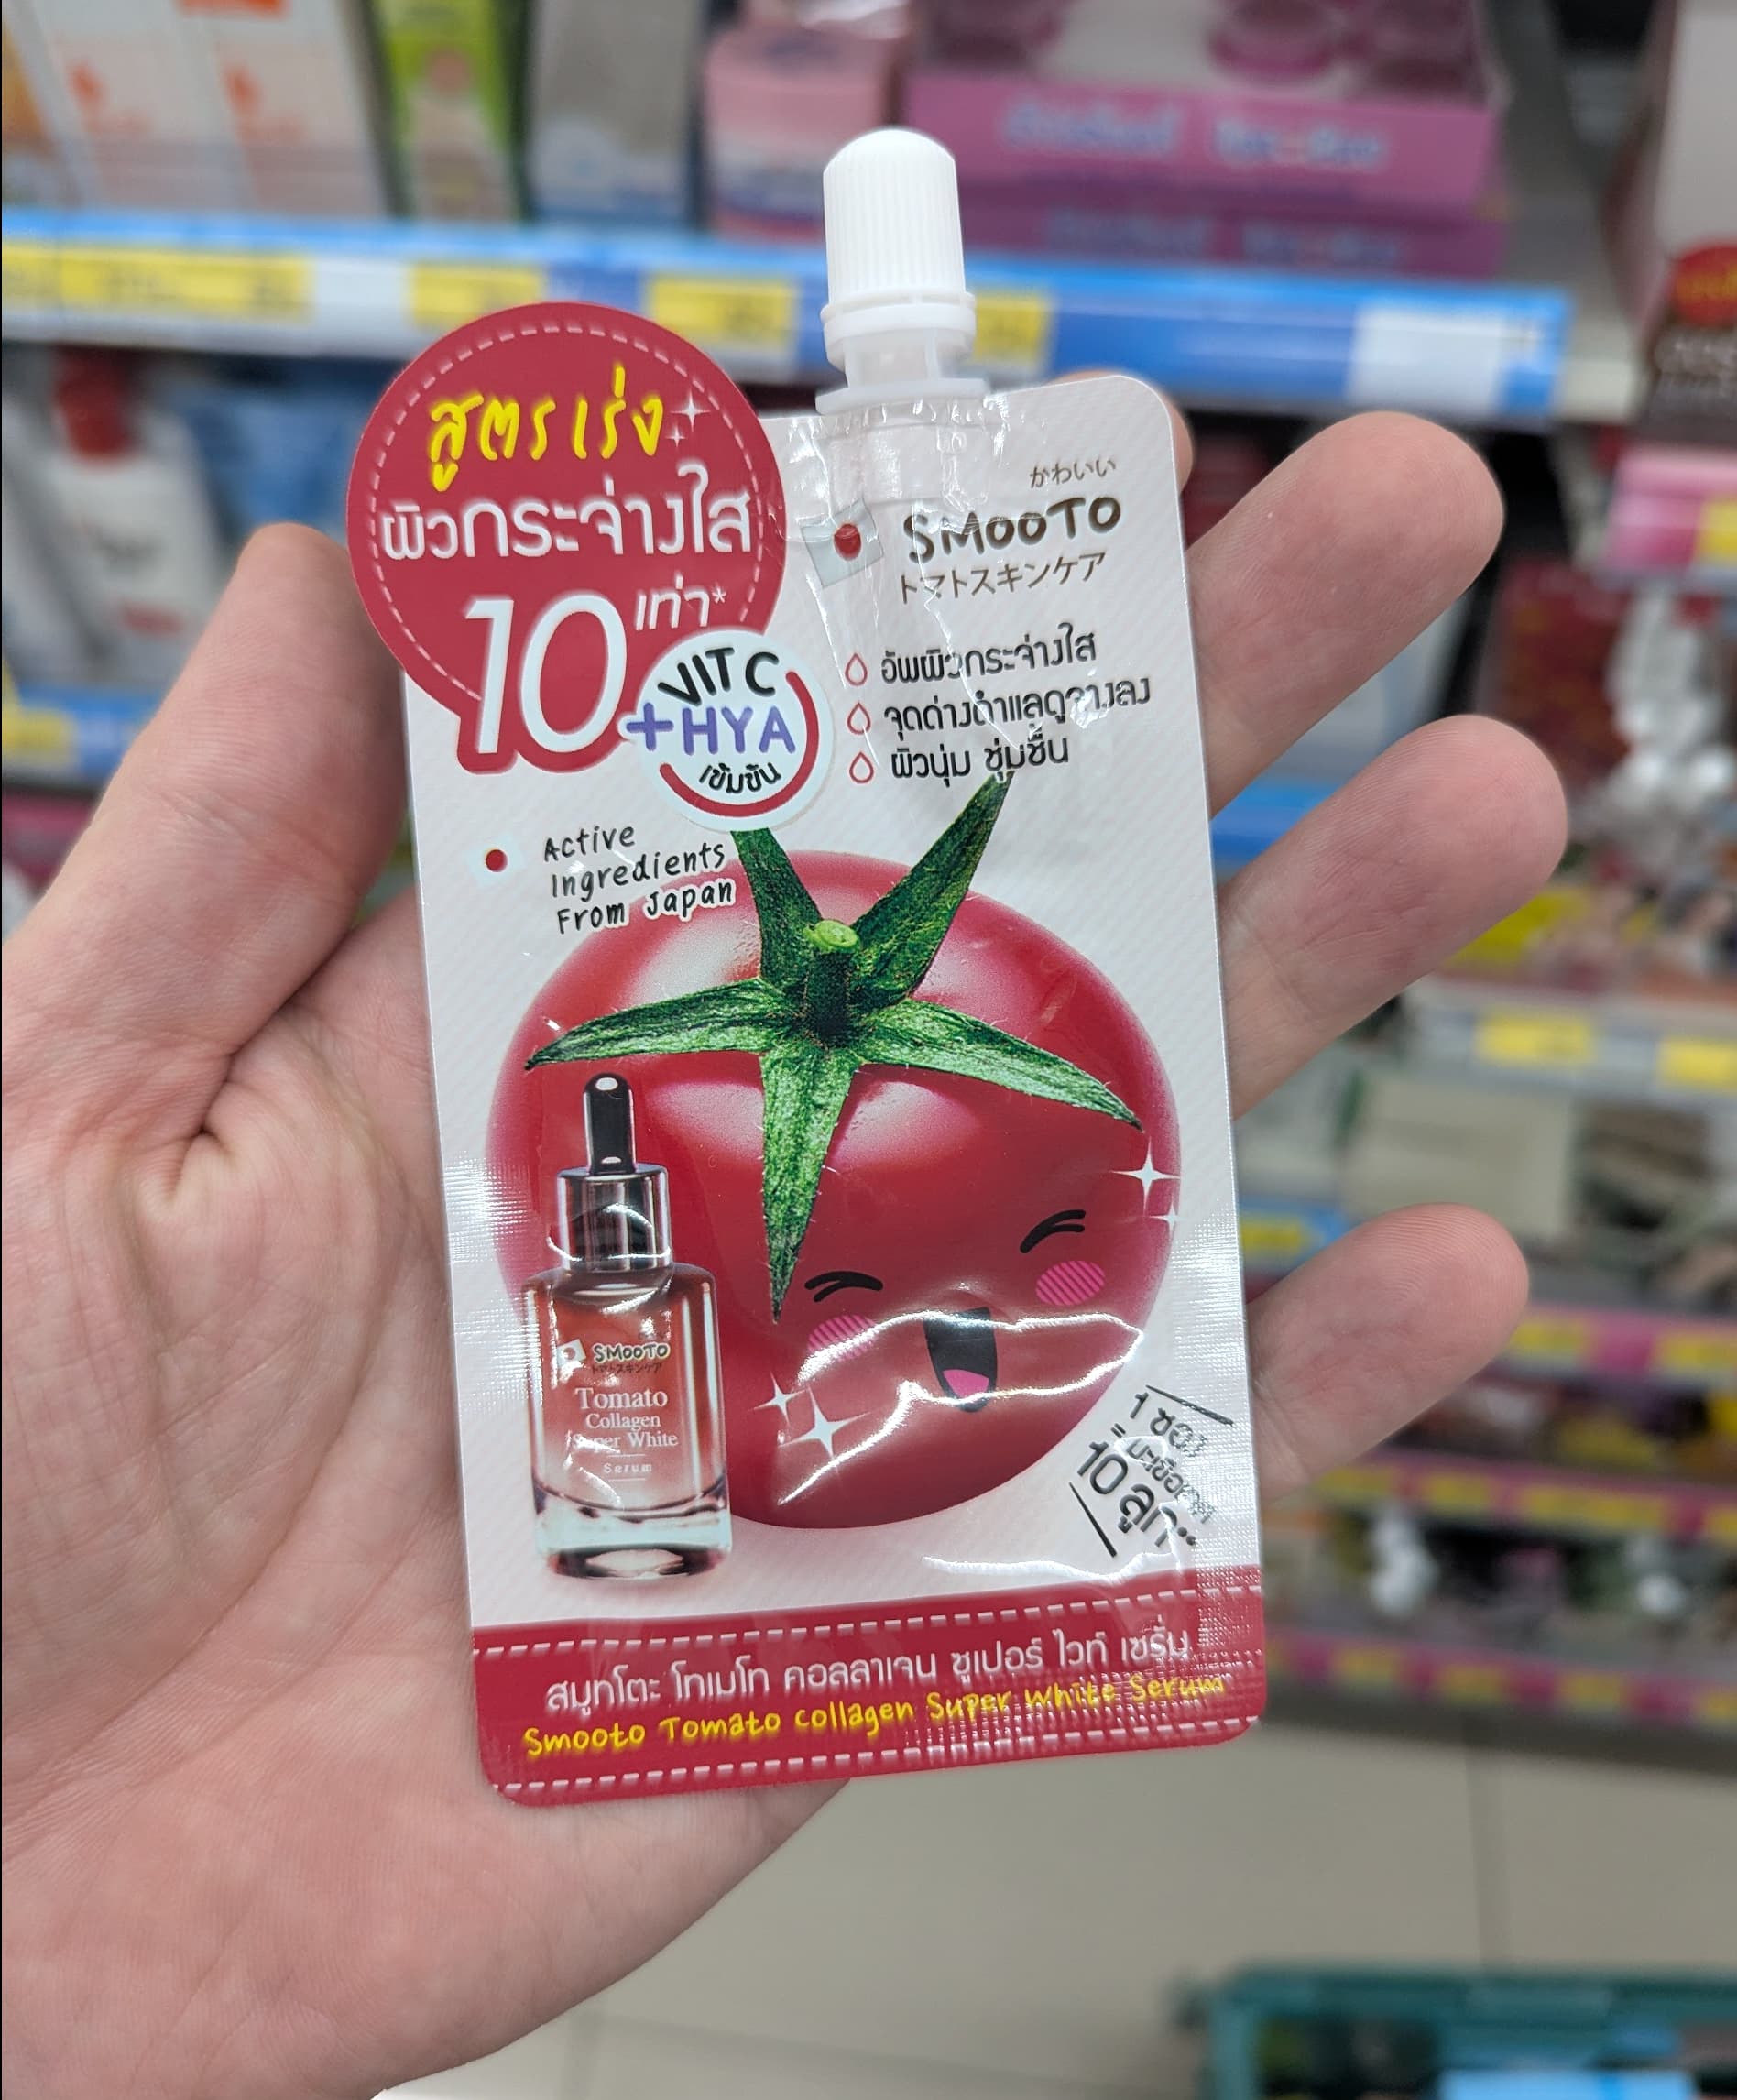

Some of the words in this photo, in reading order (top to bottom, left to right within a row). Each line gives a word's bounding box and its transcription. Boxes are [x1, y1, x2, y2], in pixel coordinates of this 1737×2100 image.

[1029, 456, 1117, 490] かわいい
[382, 463, 751, 561] ผิวกระจ่างใส
[901, 551, 1106, 605] トマトスキンケア
[465, 592, 628, 755] 10
[658, 647, 735, 706] VIT
[745, 651, 780, 697] C
[881, 622, 1097, 684] อัพผิวกระจ่างใส
[699, 762, 781, 794] เข้มข้น
[543, 826, 635, 863] Active
[551, 842, 725, 902] Ingredients
[557, 902, 626, 935] From
[645, 880, 733, 919] Japan
[575, 1387, 668, 1409] Tomato
[585, 1413, 661, 1431] Collagen
[1130, 1392, 1149, 1419] 1
[573, 1433, 621, 1453] Sper
[628, 1430, 679, 1448] White
[603, 1462, 652, 1473] Serum
[1077, 1441, 1128, 1495] 10
[545, 1665, 661, 1715] สมูทโตะ
[670, 1655, 770, 1699] โทเมโท
[783, 1652, 936, 1690] คอลลาเจน
[523, 1722, 646, 1756] Smooto
[659, 1710, 781, 1742] Tomato
[794, 1701, 913, 1737] collagen
[926, 1689, 1011, 1722] Super
[1131, 1672, 1224, 1701] Serum
